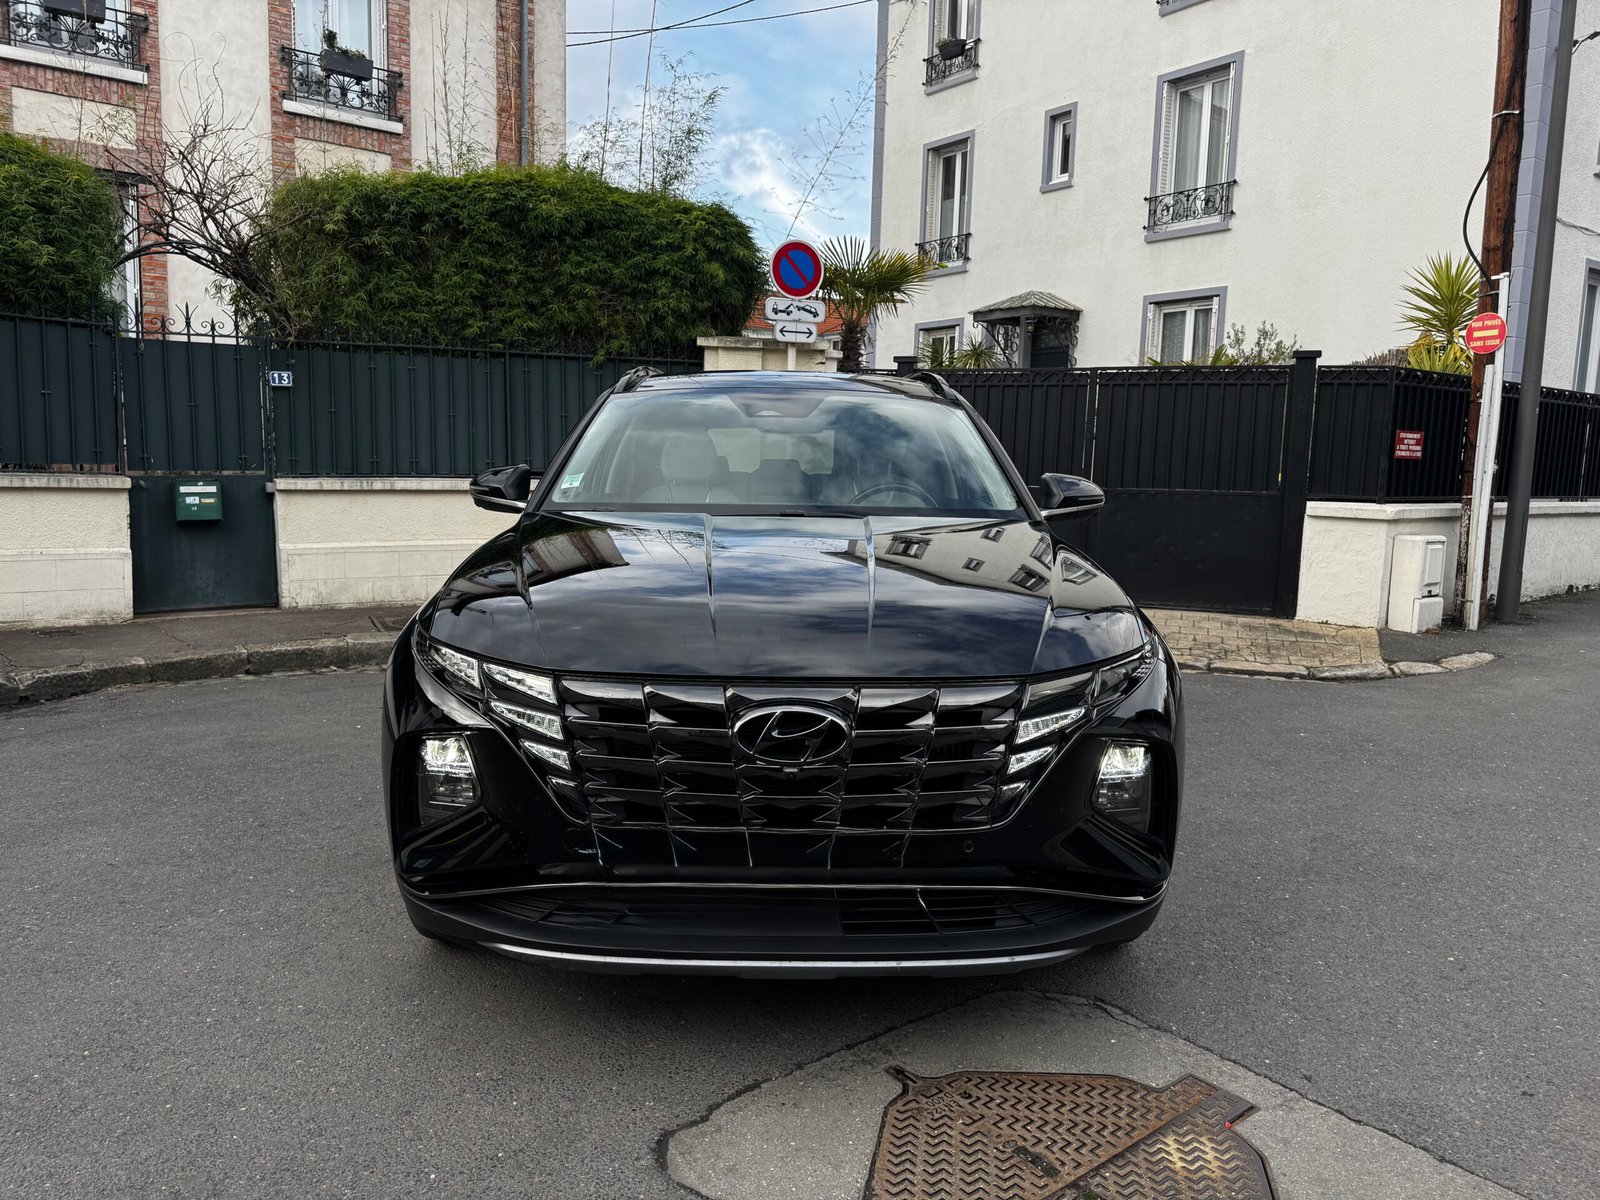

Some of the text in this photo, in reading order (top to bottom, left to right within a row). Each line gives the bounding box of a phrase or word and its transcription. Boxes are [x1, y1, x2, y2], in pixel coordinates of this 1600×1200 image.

[1471, 320, 1484, 328] VOIE
[1485, 338, 1501, 346] ISSUE
[273, 373, 289, 384] 13
[926, 1092, 954, 1107] D400
